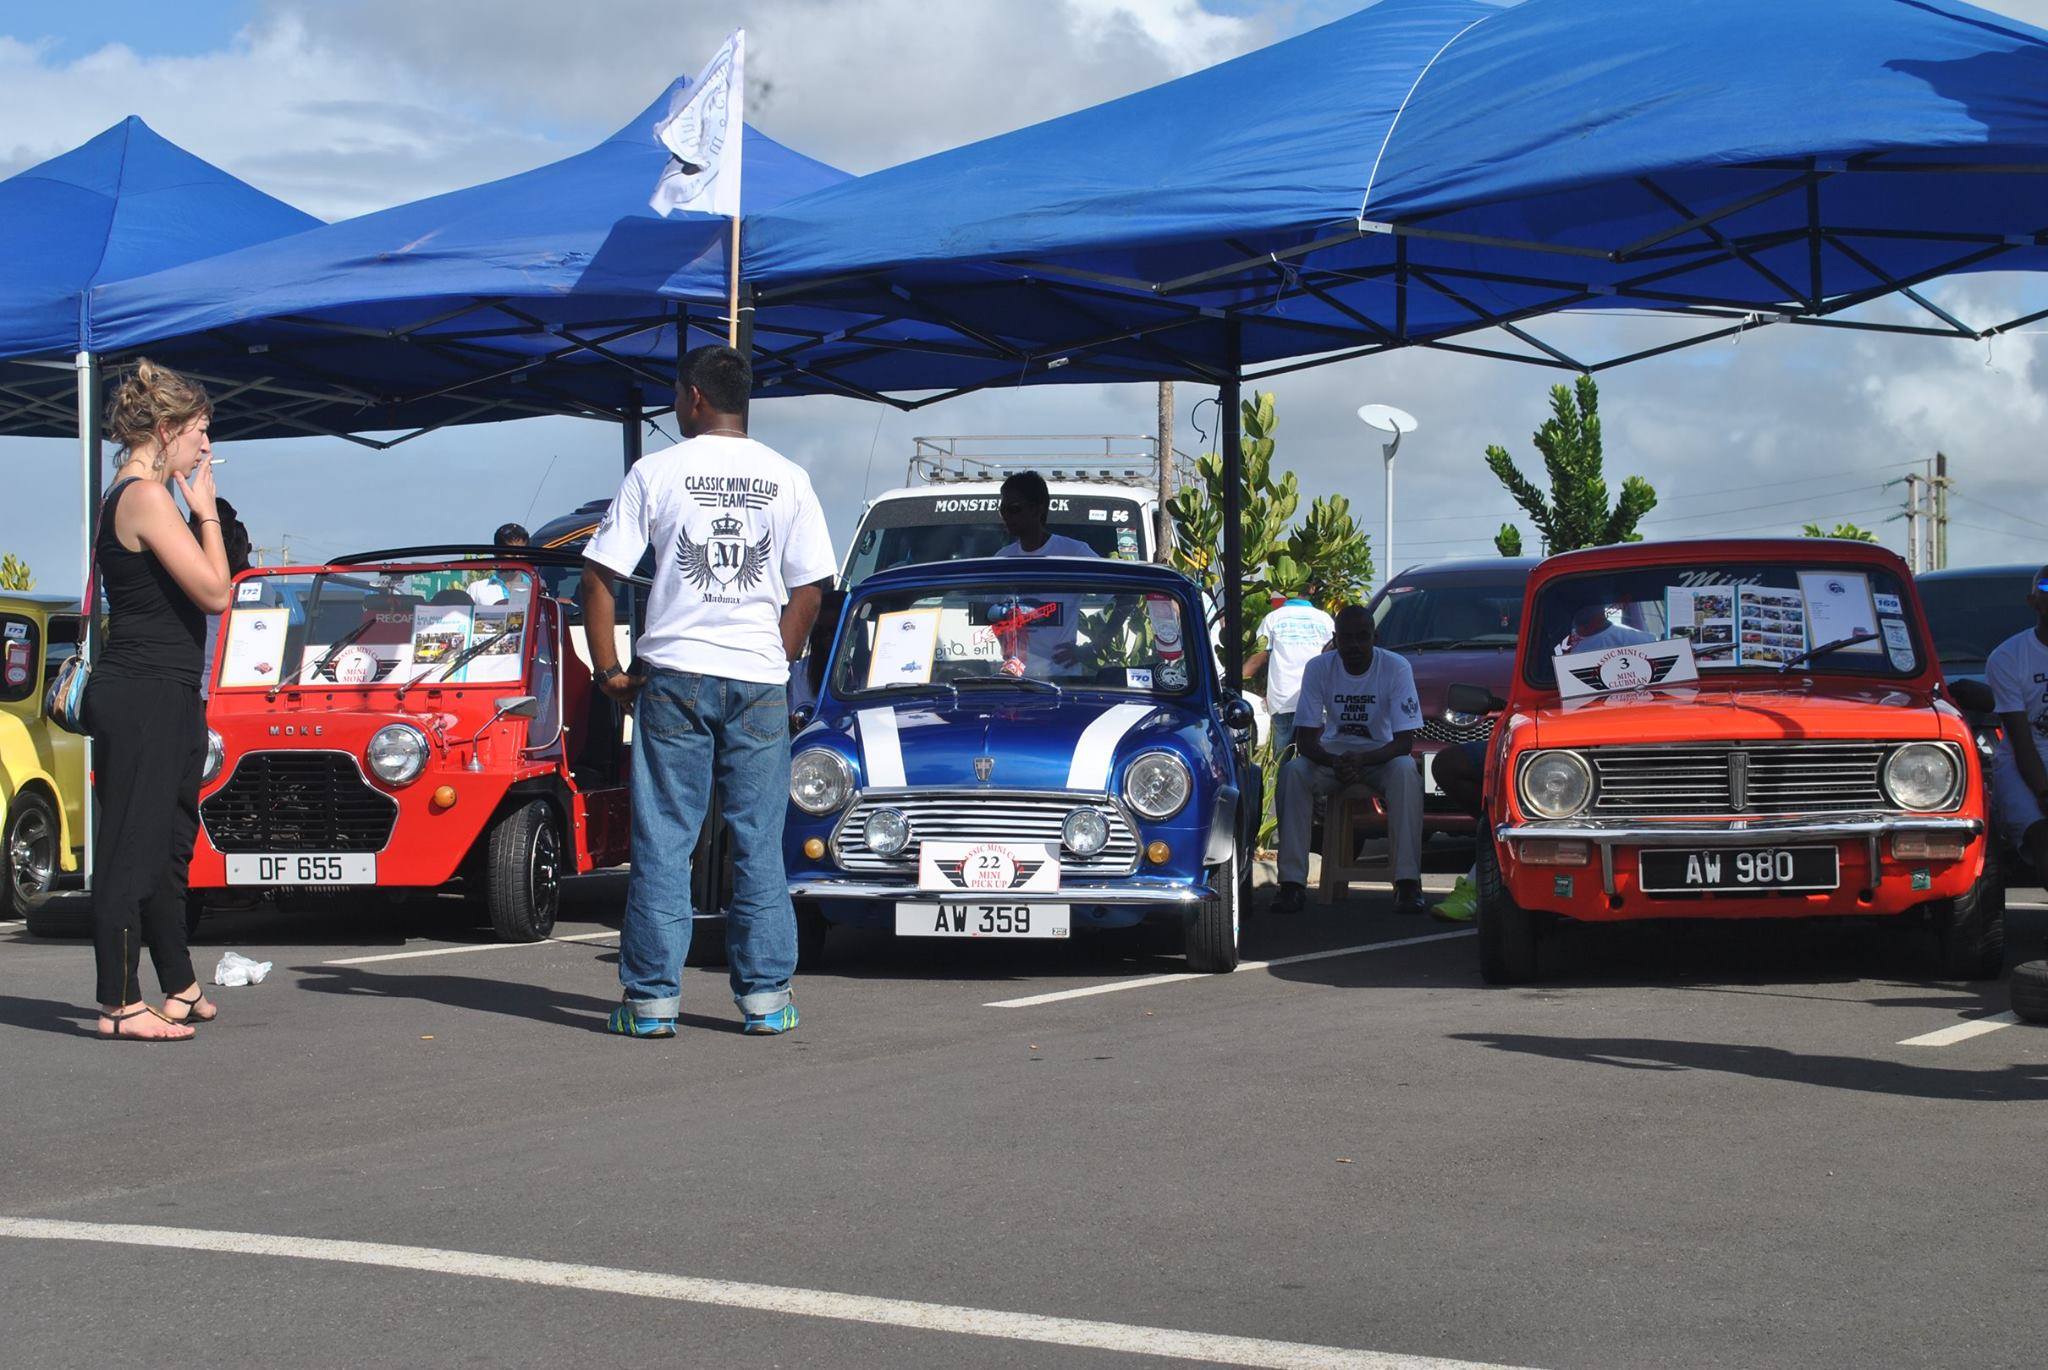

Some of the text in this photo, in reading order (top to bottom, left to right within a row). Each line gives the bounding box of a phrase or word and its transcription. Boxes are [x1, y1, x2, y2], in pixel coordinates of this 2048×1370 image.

[684, 475, 779, 498] CLASSIC MINI CLUB
[718, 493, 746, 508] TEAM
[1111, 510, 1129, 523] 56
[1678, 570, 1763, 588] Mini
[241, 588, 259, 596] 172
[1878, 599, 1898, 608] 169
[1617, 648, 1637, 657] MINI
[354, 657, 362, 669] 7
[1619, 657, 1631, 670] 3
[1130, 674, 1150, 682] 170
[1616, 671, 1637, 680] MINI
[1608, 676, 1649, 689] CLUBMAN
[1334, 694, 1377, 704] CLASSIC
[1343, 704, 1366, 713] MINI
[1340, 712, 1369, 721] CLUB
[269, 725, 323, 736] MOKE
[987, 843, 1006, 855] MINI
[259, 856, 342, 881] DF 655
[978, 856, 1002, 869] 22
[1685, 851, 1794, 884] AW 980
[978, 871, 1001, 880] MINI
[971, 880, 1008, 889] PICK UP
[934, 905, 1031, 934] AW 359
